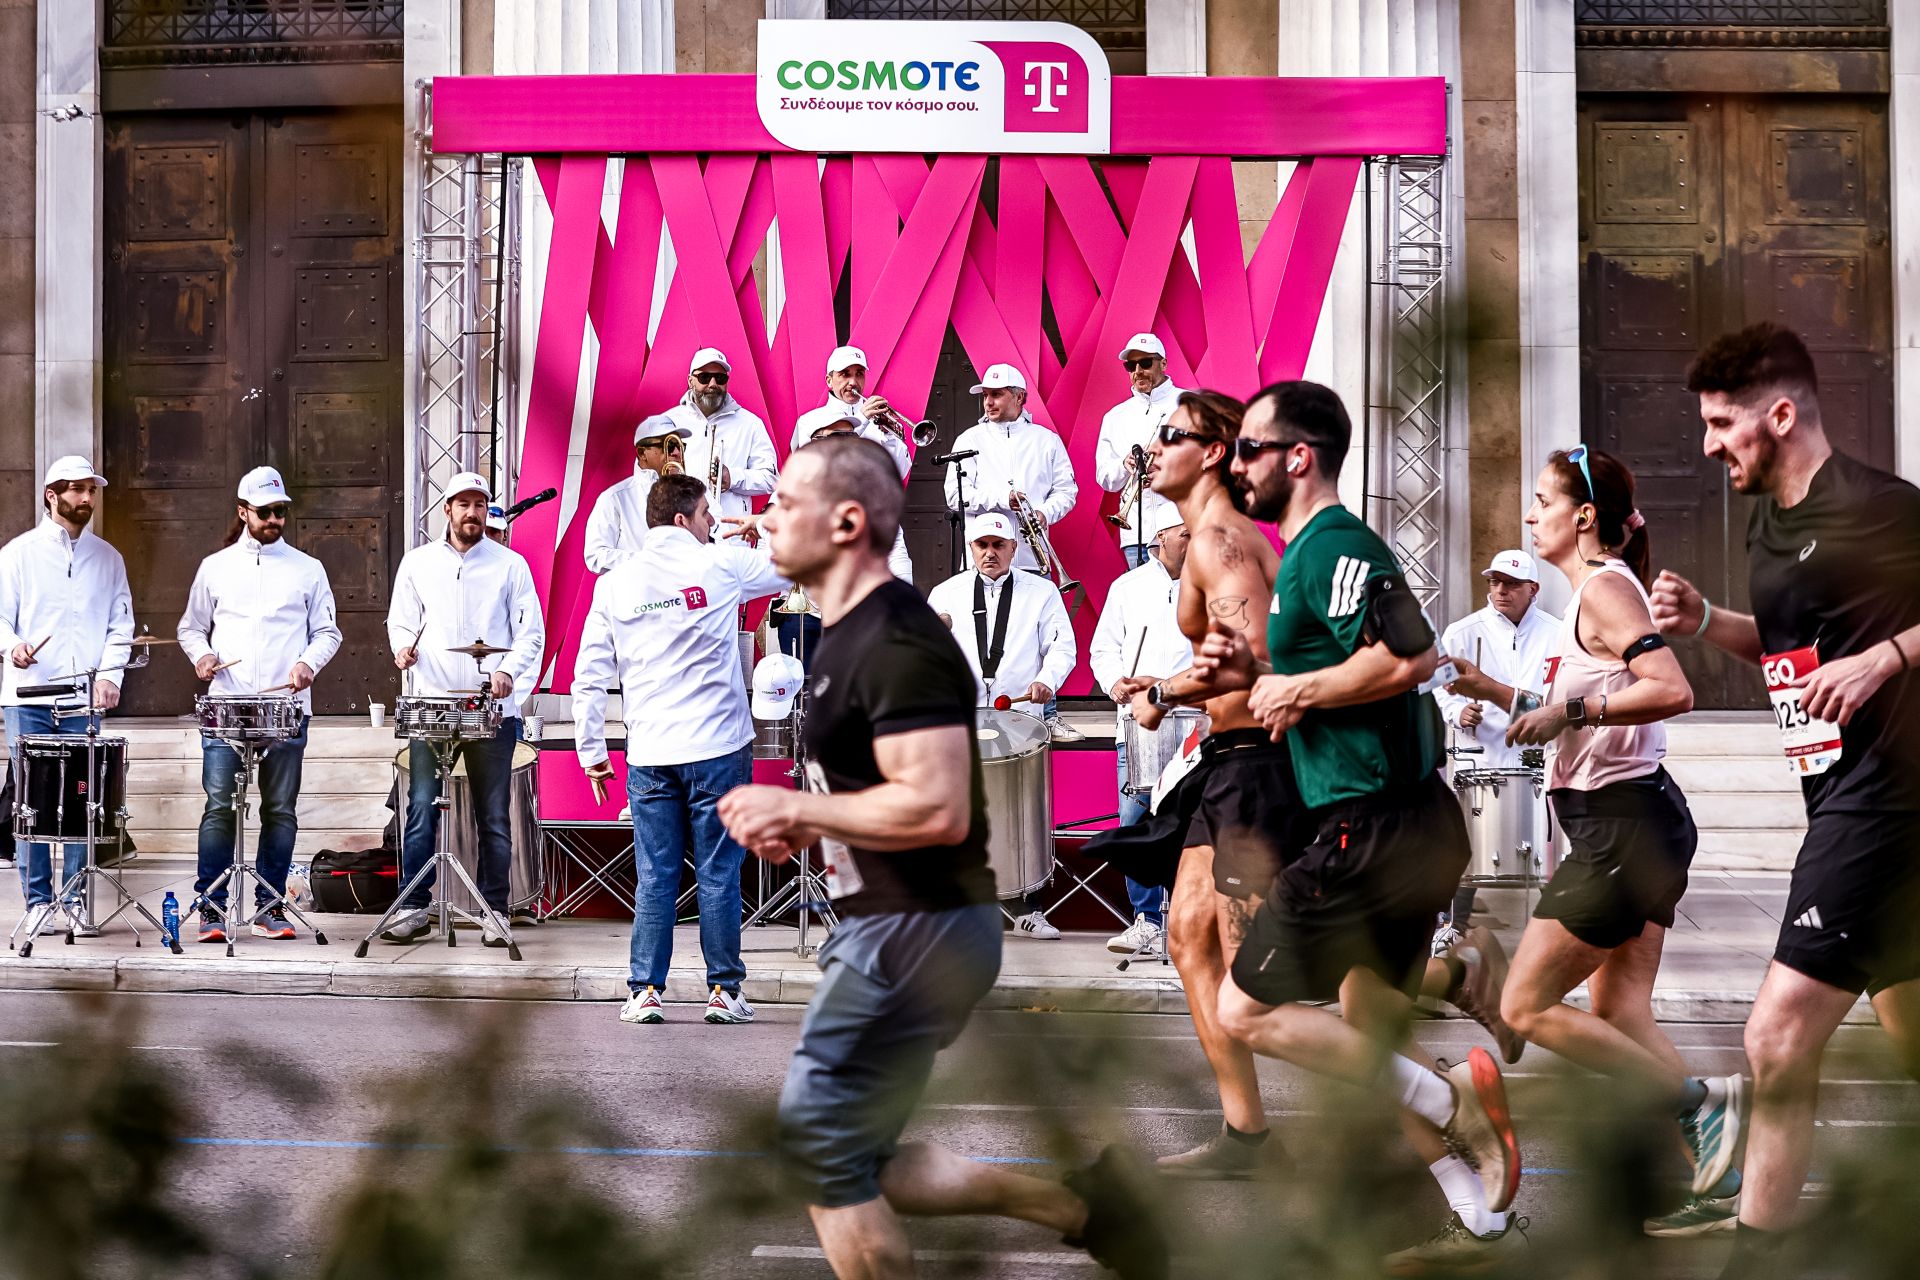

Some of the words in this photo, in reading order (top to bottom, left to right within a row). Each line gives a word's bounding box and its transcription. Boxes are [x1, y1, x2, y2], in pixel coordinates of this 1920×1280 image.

[777, 60, 980, 91] COSMOTE
[780, 97, 863, 113] Συνδέουμε
[867, 101, 892, 111] τον
[896, 98, 943, 114] κόσμο
[946, 101, 979, 111] σου.
[634, 598, 681, 614] COSMOTE
[1763, 657, 1795, 687] GO
